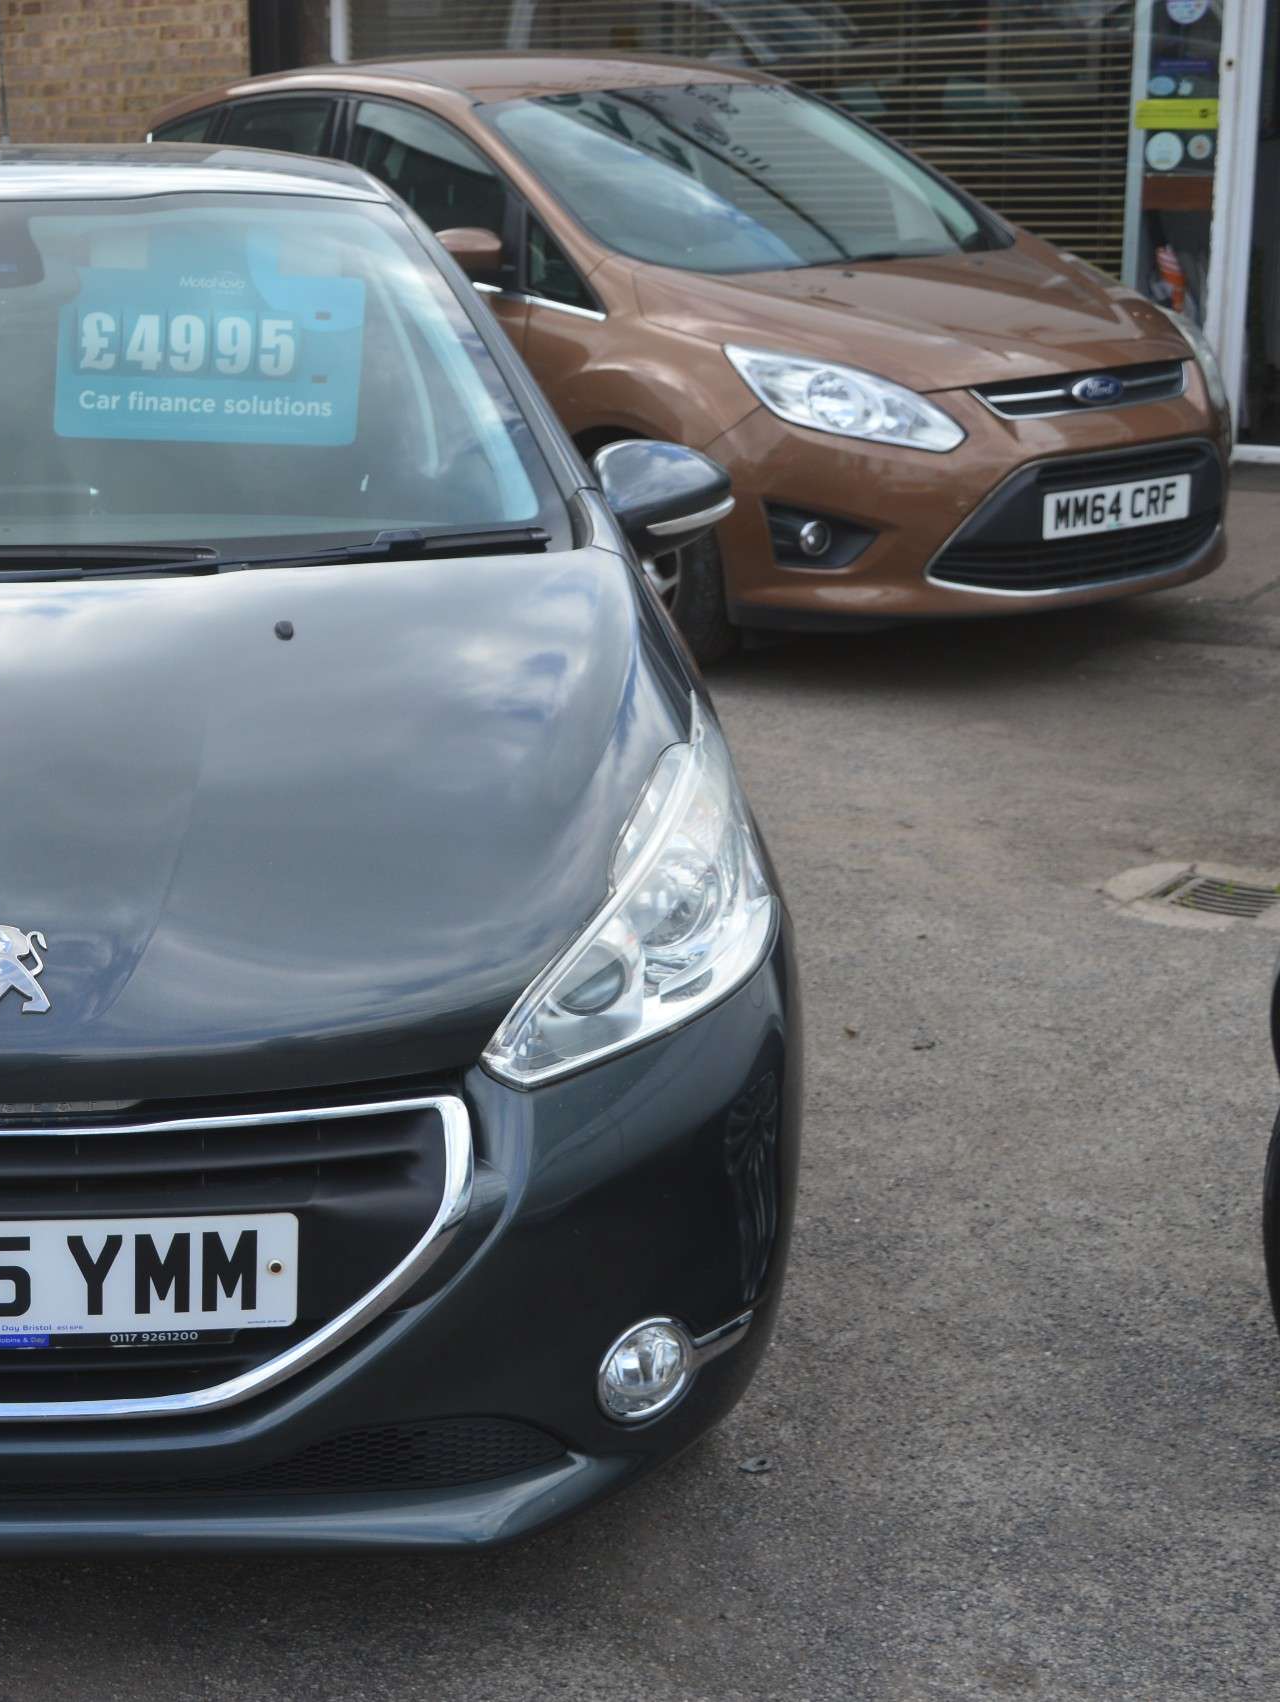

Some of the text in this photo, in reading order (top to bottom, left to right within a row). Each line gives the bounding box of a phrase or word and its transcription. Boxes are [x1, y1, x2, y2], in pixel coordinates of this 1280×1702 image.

[79, 311, 296, 377] £4995
[79, 390, 333, 418] Car finance solutions
[1053, 481, 1177, 530] MM64 CRF
[66, 1229, 258, 1316] YMM
[1, 1324, 20, 1334] Day
[23, 1324, 52, 1332] Bristol
[109, 1331, 199, 1343] 0117 9261200
